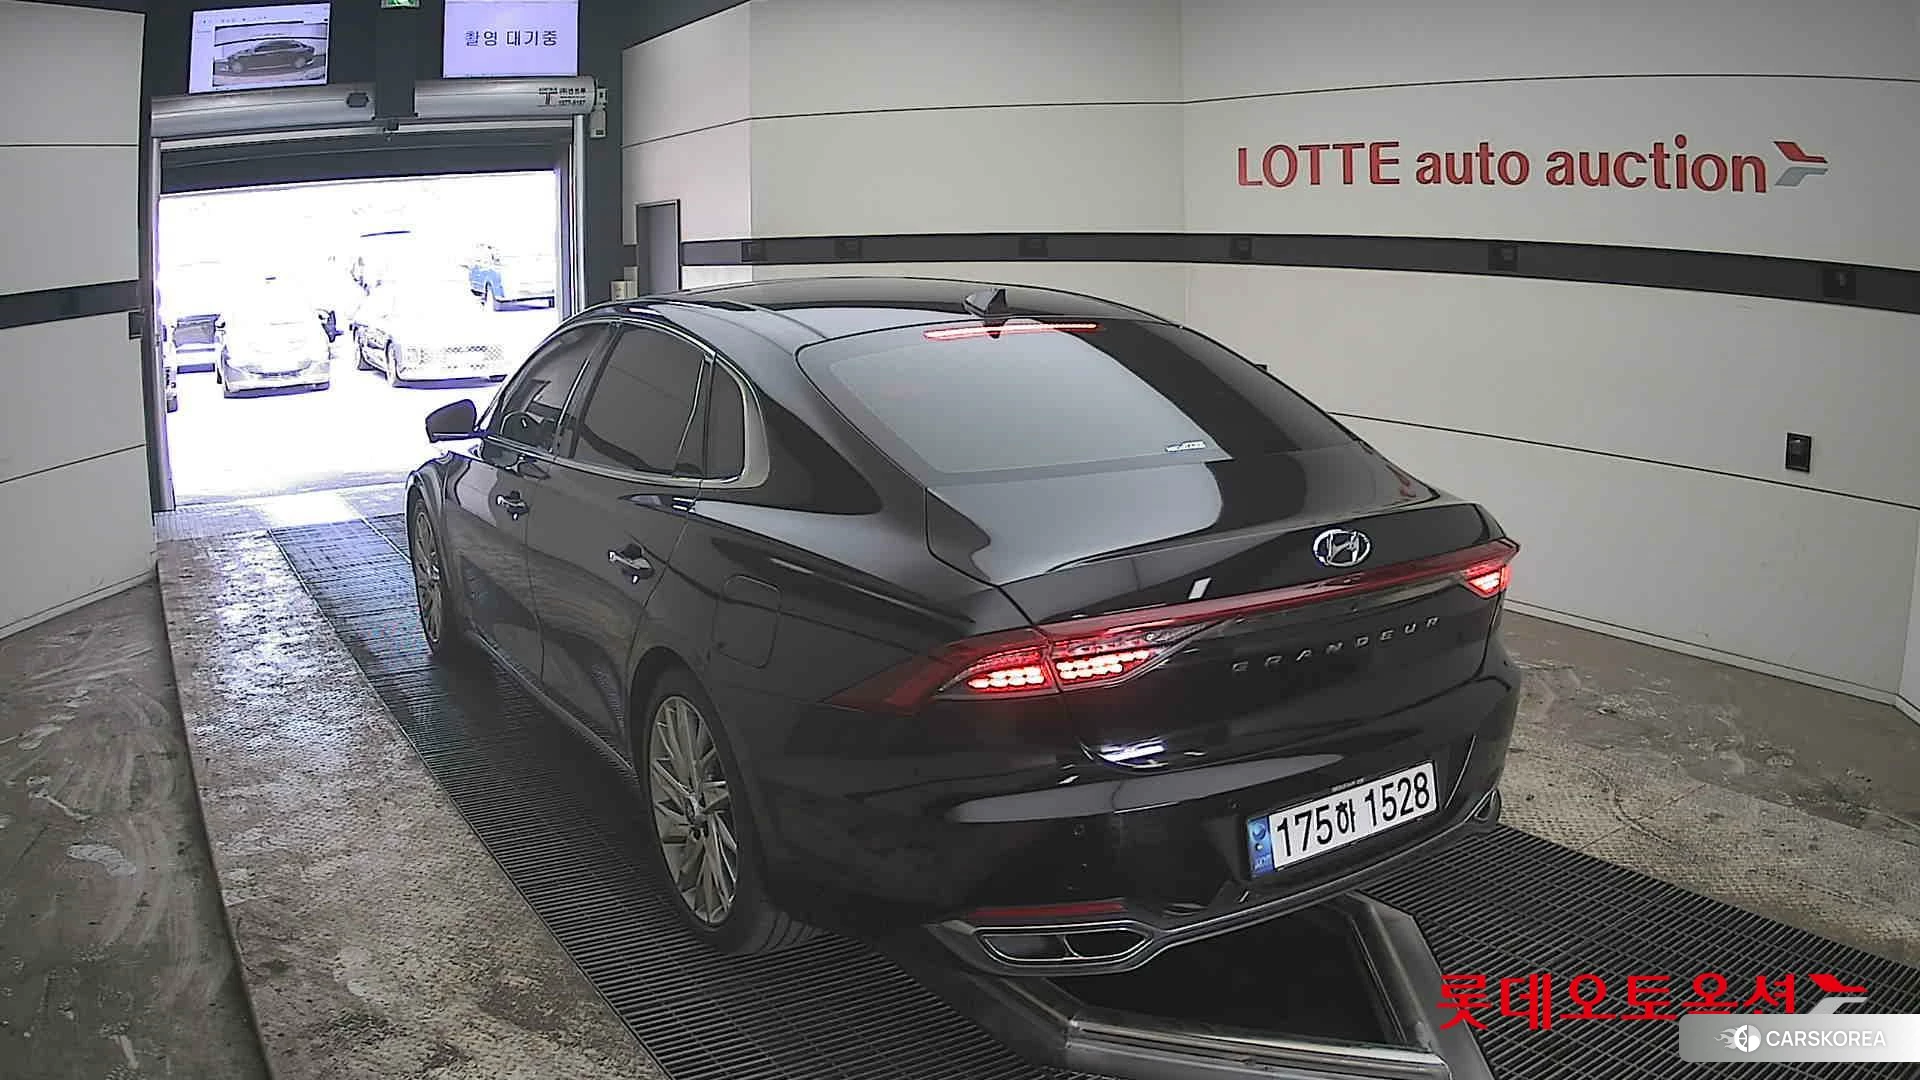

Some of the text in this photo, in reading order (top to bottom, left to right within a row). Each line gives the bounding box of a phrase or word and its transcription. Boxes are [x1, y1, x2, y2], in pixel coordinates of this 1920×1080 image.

[465, 30, 558, 47] 촬영 대기중
[1237, 134, 1767, 193] LOTTE auto auction
[1231, 616, 1440, 672] GRANDEUR
[1277, 772, 1431, 857] 175하 1528
